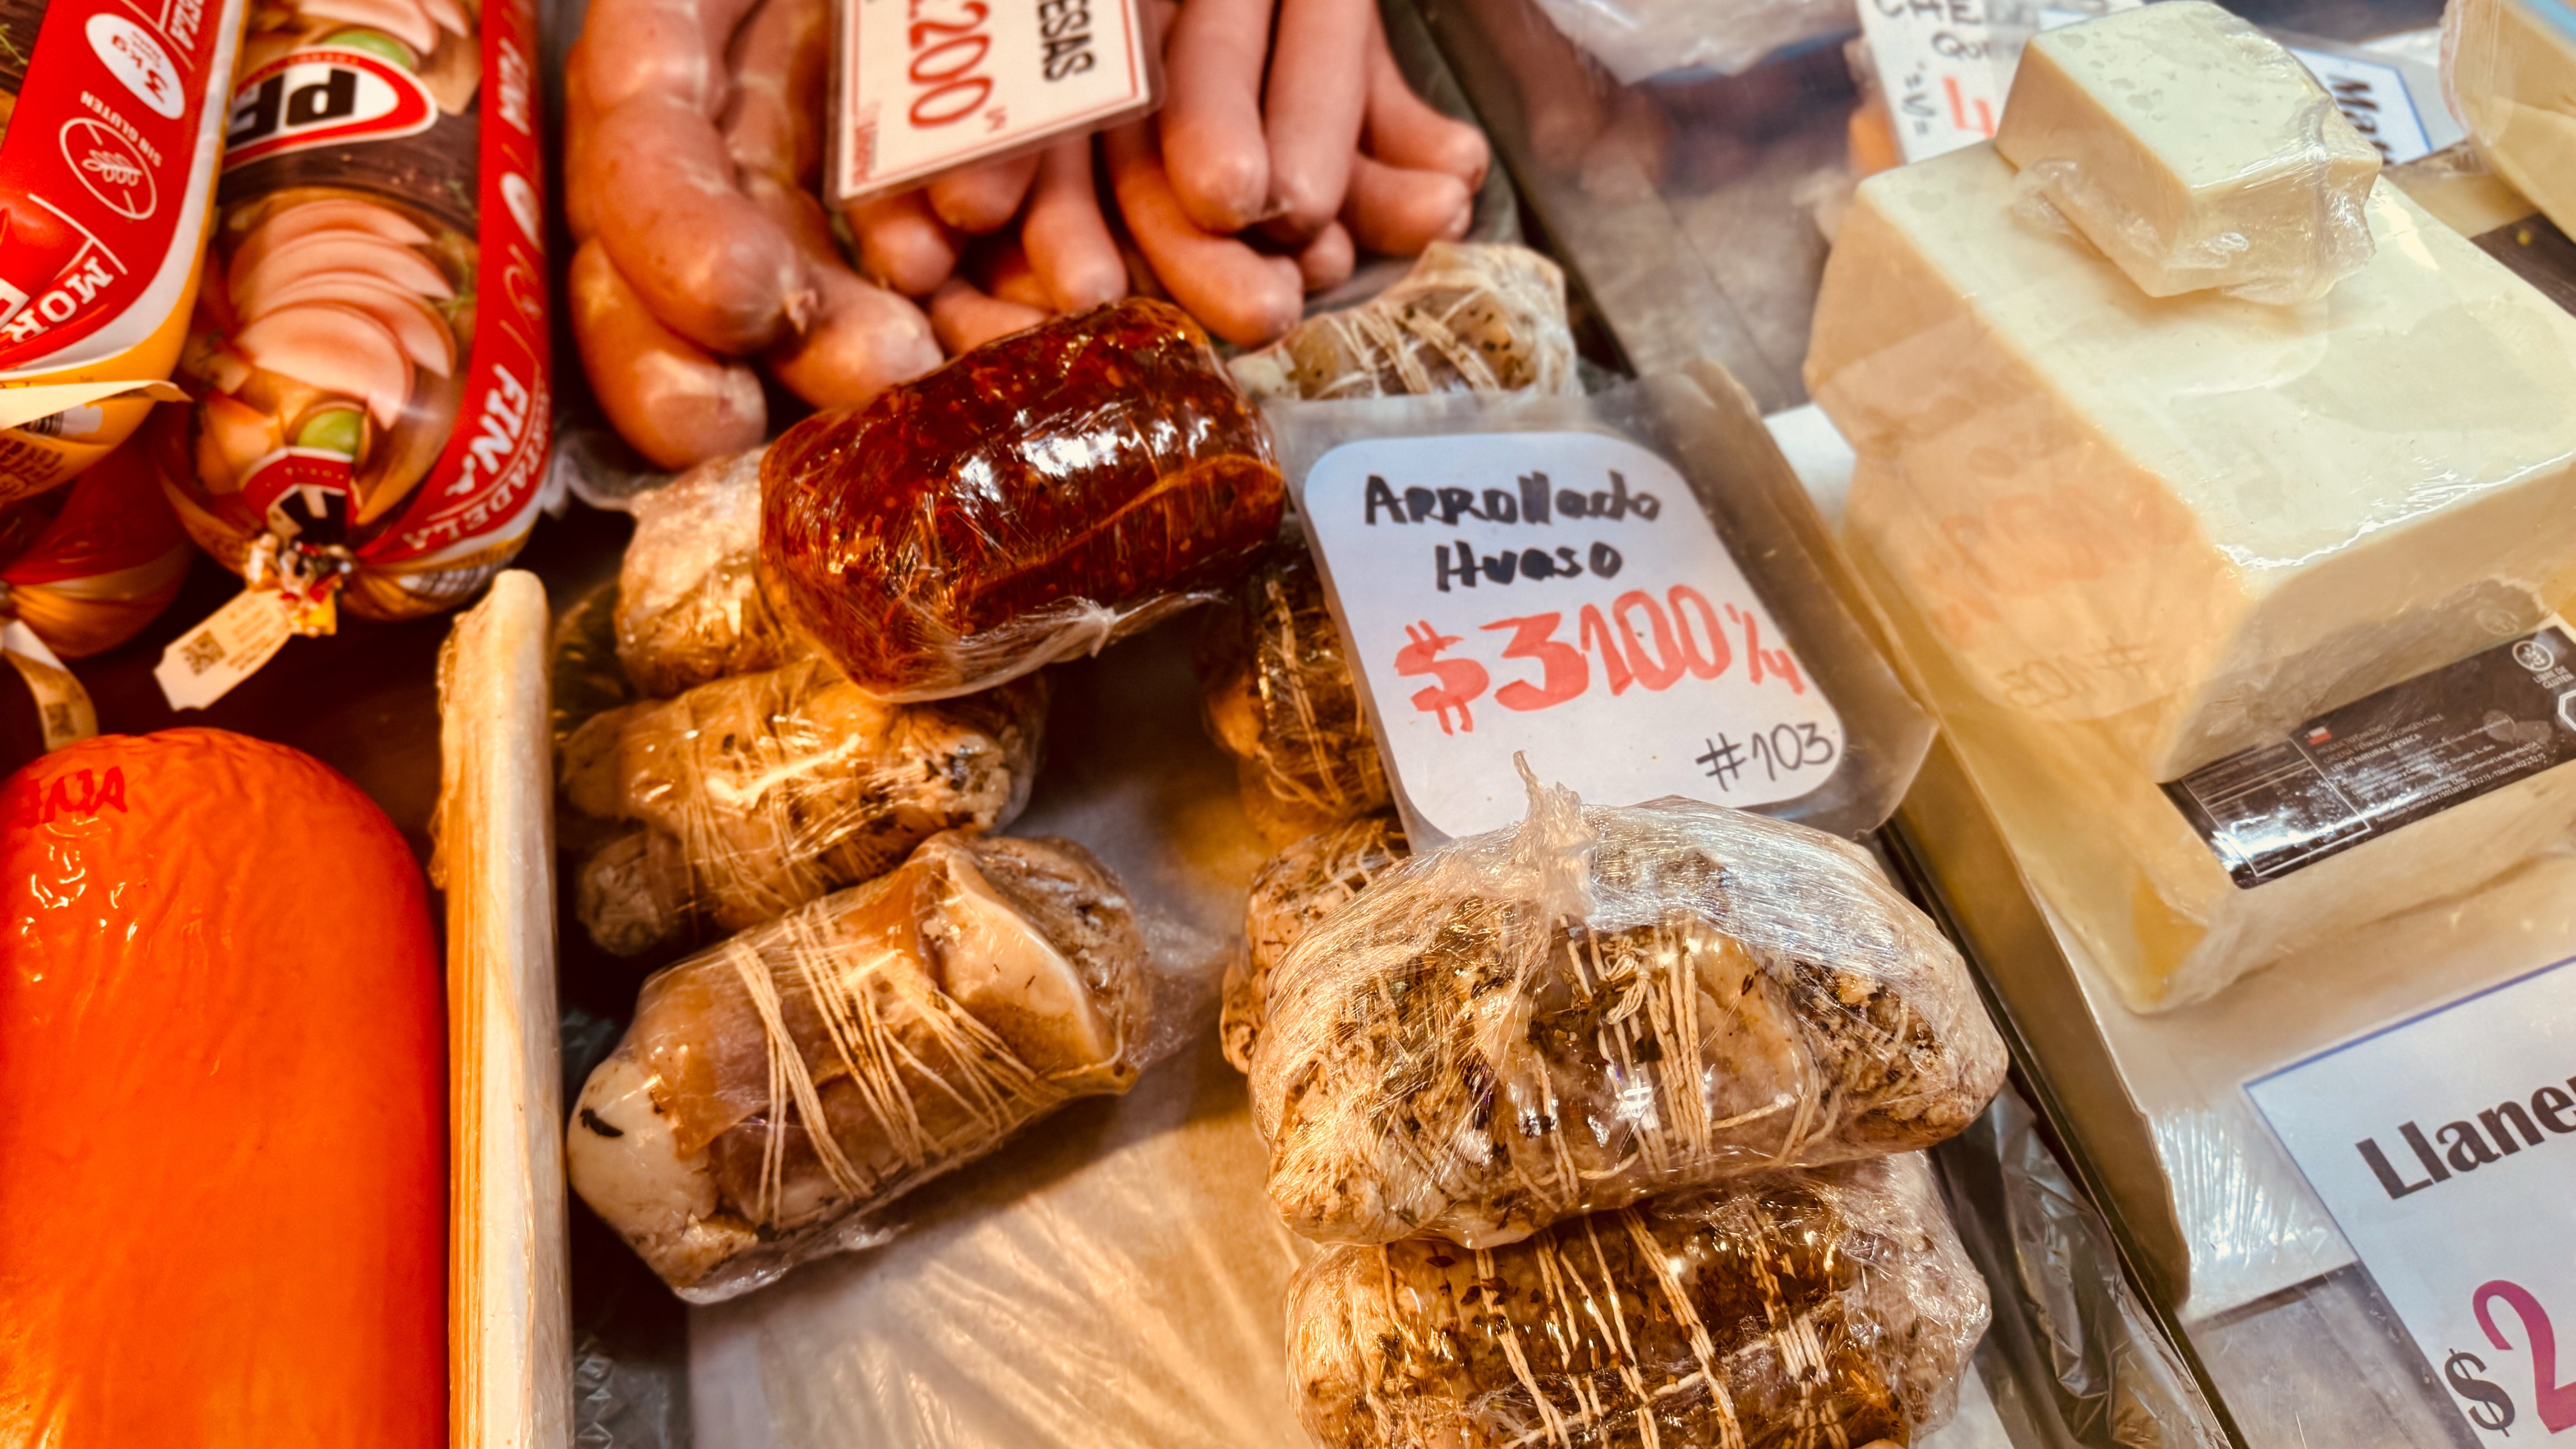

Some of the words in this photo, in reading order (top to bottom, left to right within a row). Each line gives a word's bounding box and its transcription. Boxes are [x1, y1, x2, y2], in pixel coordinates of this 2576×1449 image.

[80, 90, 139, 143] GLUTEN
[138, 137, 163, 168] SIN
[2533, 670, 2557, 683] LIBRE
[2555, 665, 2569, 676] DE
[2543, 673, 2575, 689] GLUTEN
[1695, 722, 1835, 792] #103
